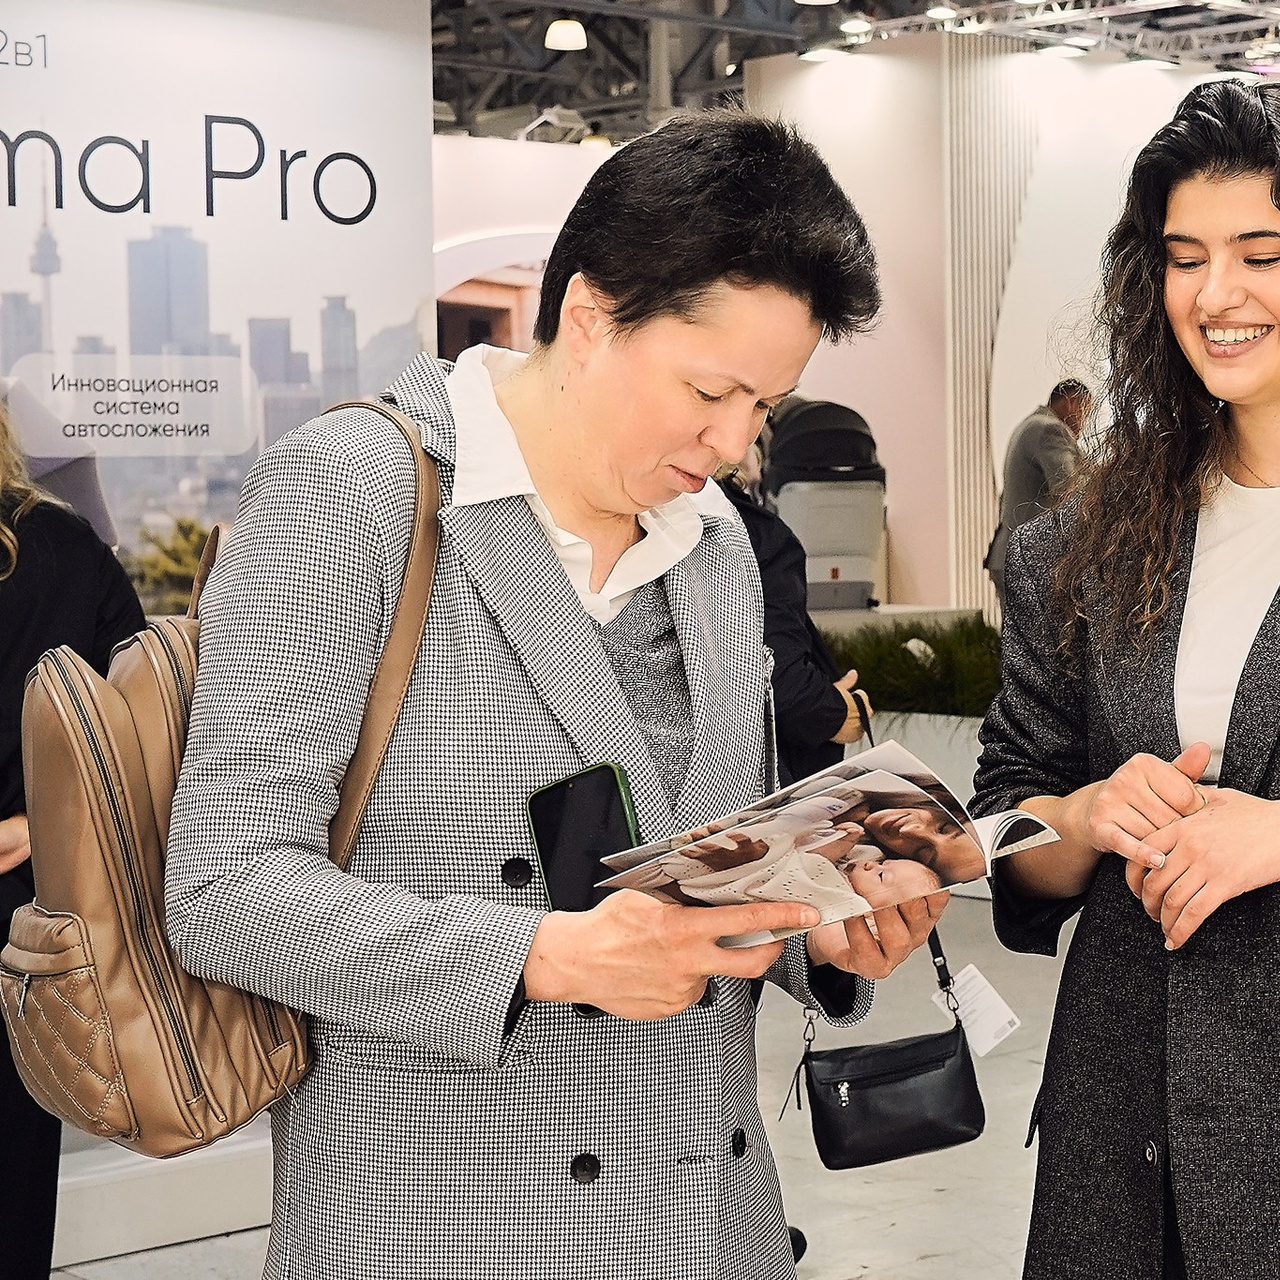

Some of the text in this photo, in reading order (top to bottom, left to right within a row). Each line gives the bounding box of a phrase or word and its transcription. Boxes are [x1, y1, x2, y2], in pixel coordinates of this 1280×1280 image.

[204, 114, 377, 225] Pro
[51, 373, 219, 395] Инновационная
[93, 401, 180, 415] система
[62, 423, 210, 438] автосложения
